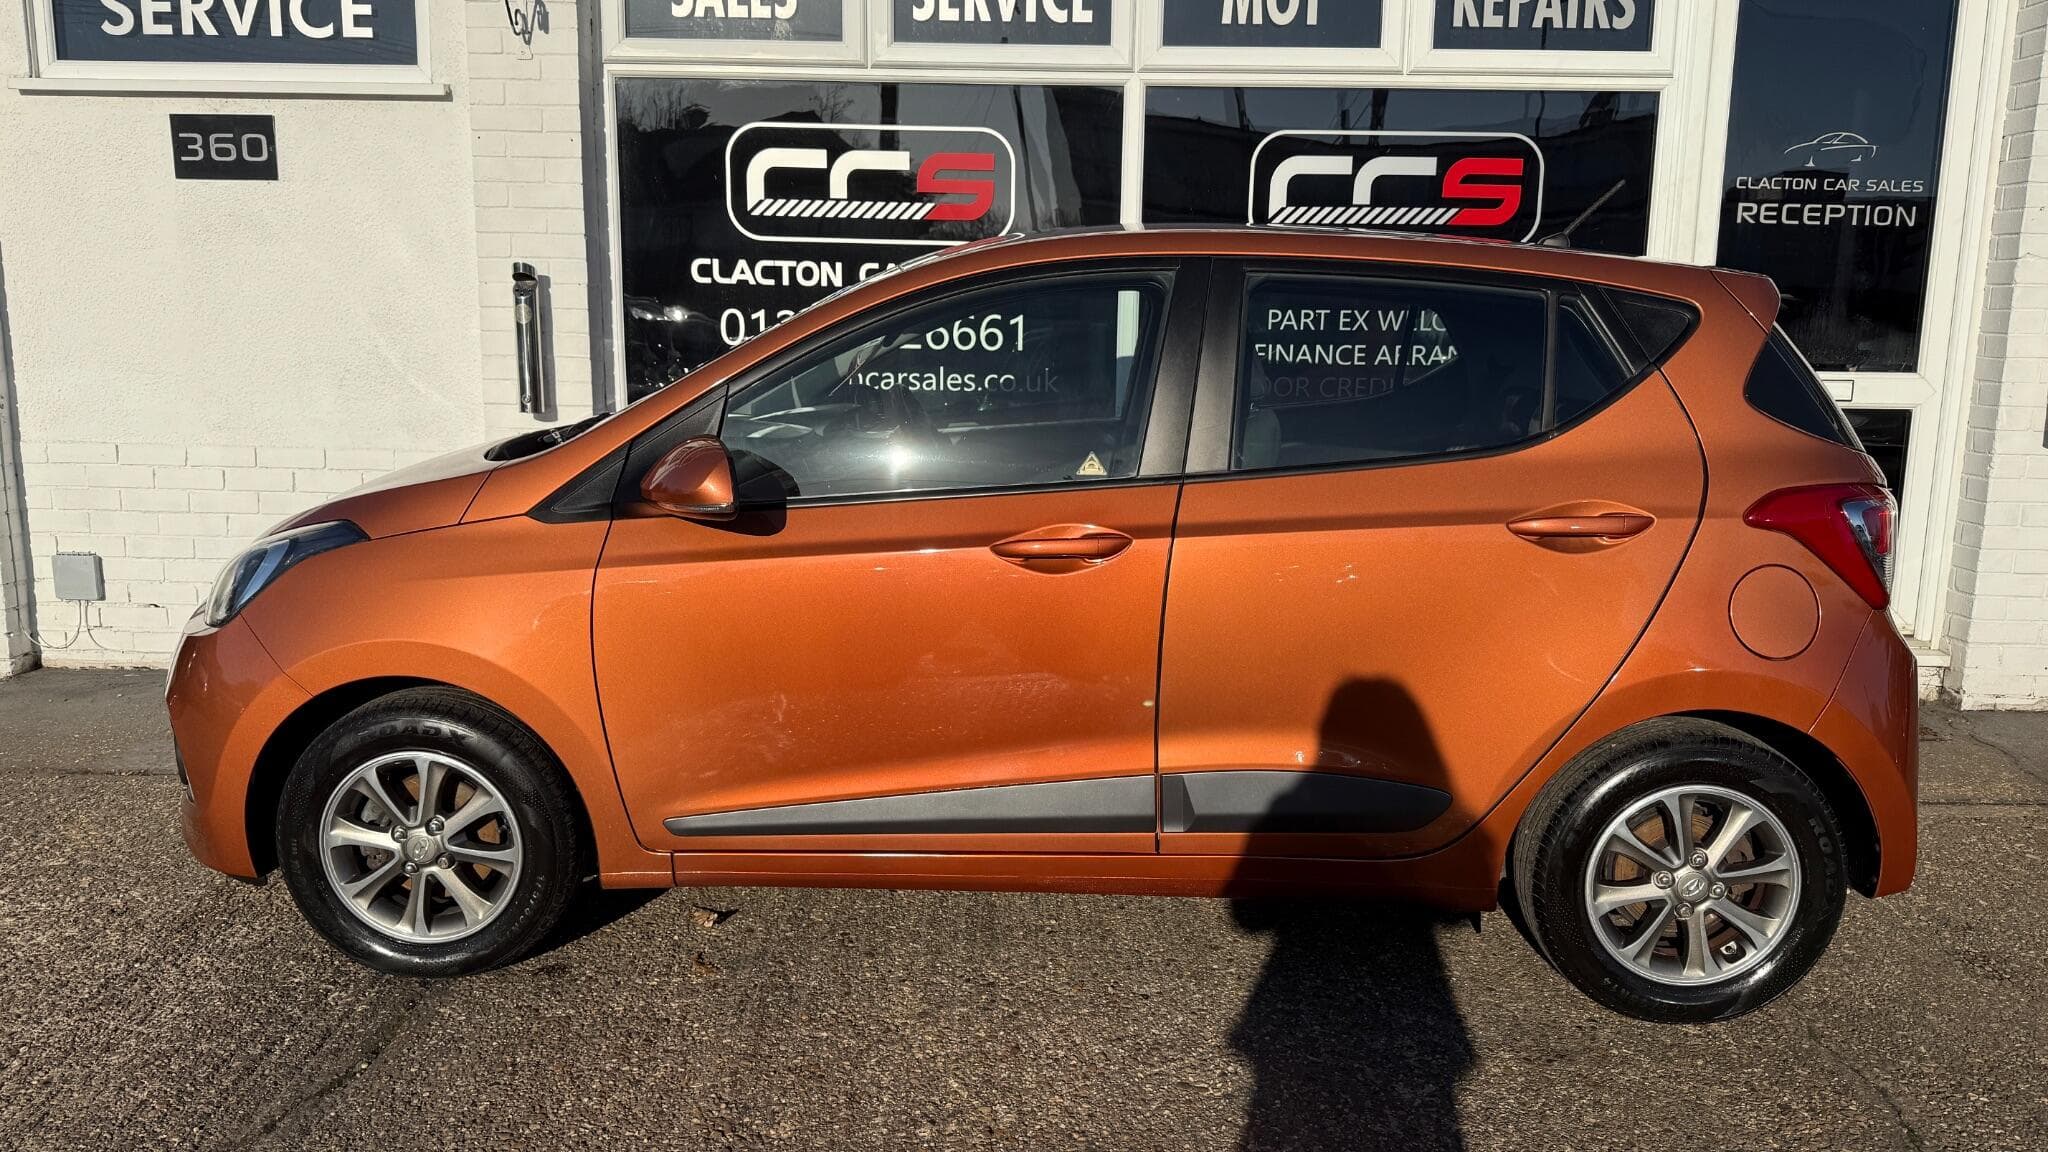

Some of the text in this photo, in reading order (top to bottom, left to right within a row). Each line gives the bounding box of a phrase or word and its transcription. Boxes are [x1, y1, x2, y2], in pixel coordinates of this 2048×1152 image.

[100, 0, 374, 39] SERVICE
[178, 133, 268, 161] 360
[1736, 176, 1924, 192] CLACTON CAR SALES
[1736, 203, 1917, 227] RECEPTION
[690, 257, 843, 287] CLACTON
[1267, 309, 1330, 331] PART
[1338, 310, 1370, 331] EX
